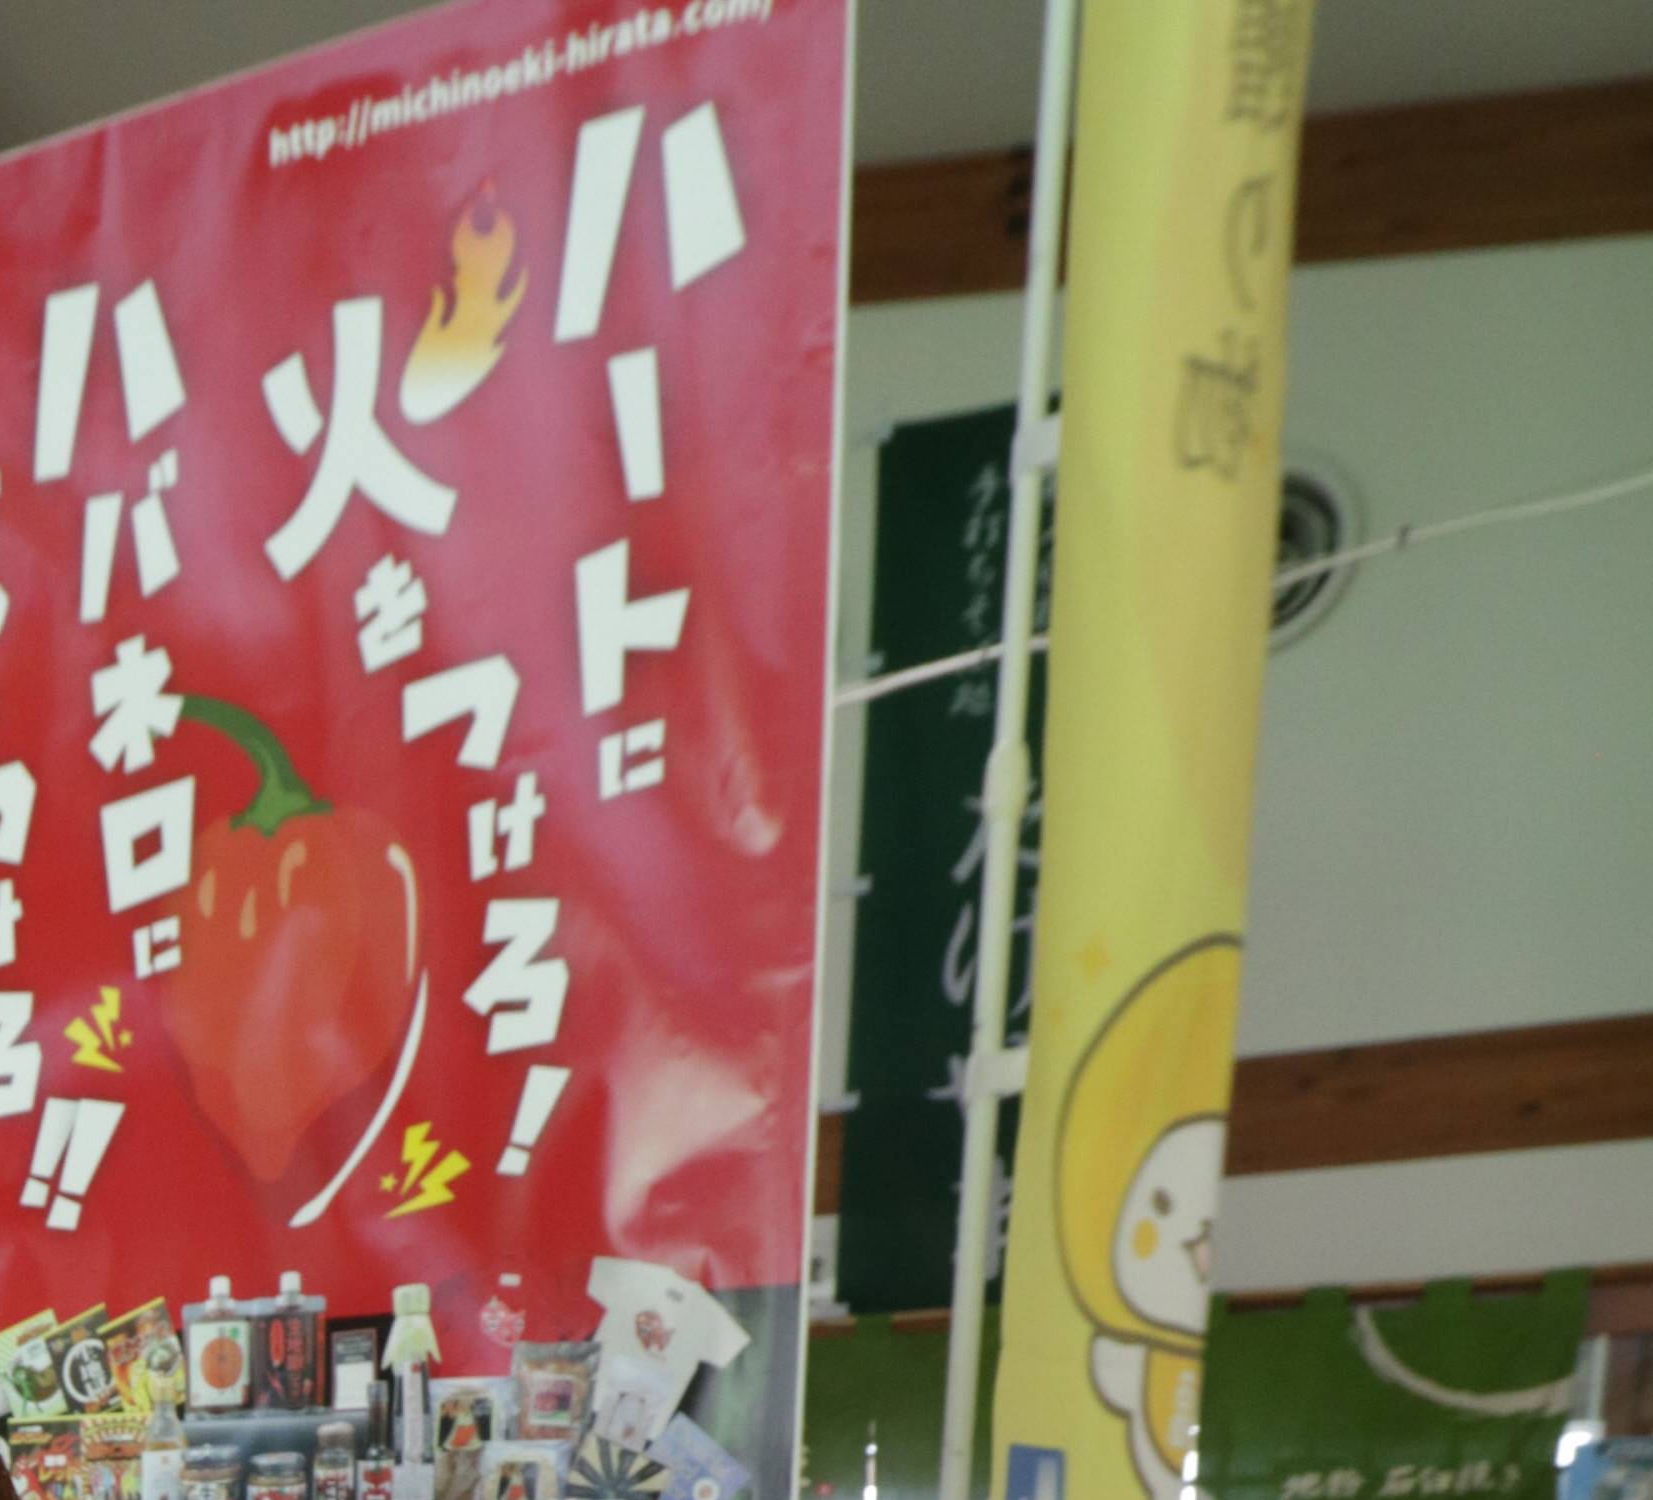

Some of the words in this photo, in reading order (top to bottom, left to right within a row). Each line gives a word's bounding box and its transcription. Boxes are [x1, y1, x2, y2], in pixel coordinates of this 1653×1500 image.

[267, 0, 775, 168] http://michinoeki-hirata.com/
[31, 278, 195, 980] ハバネロに
[260, 294, 571, 1176] 火をつけろ!
[551, 99, 747, 802] ハートに
